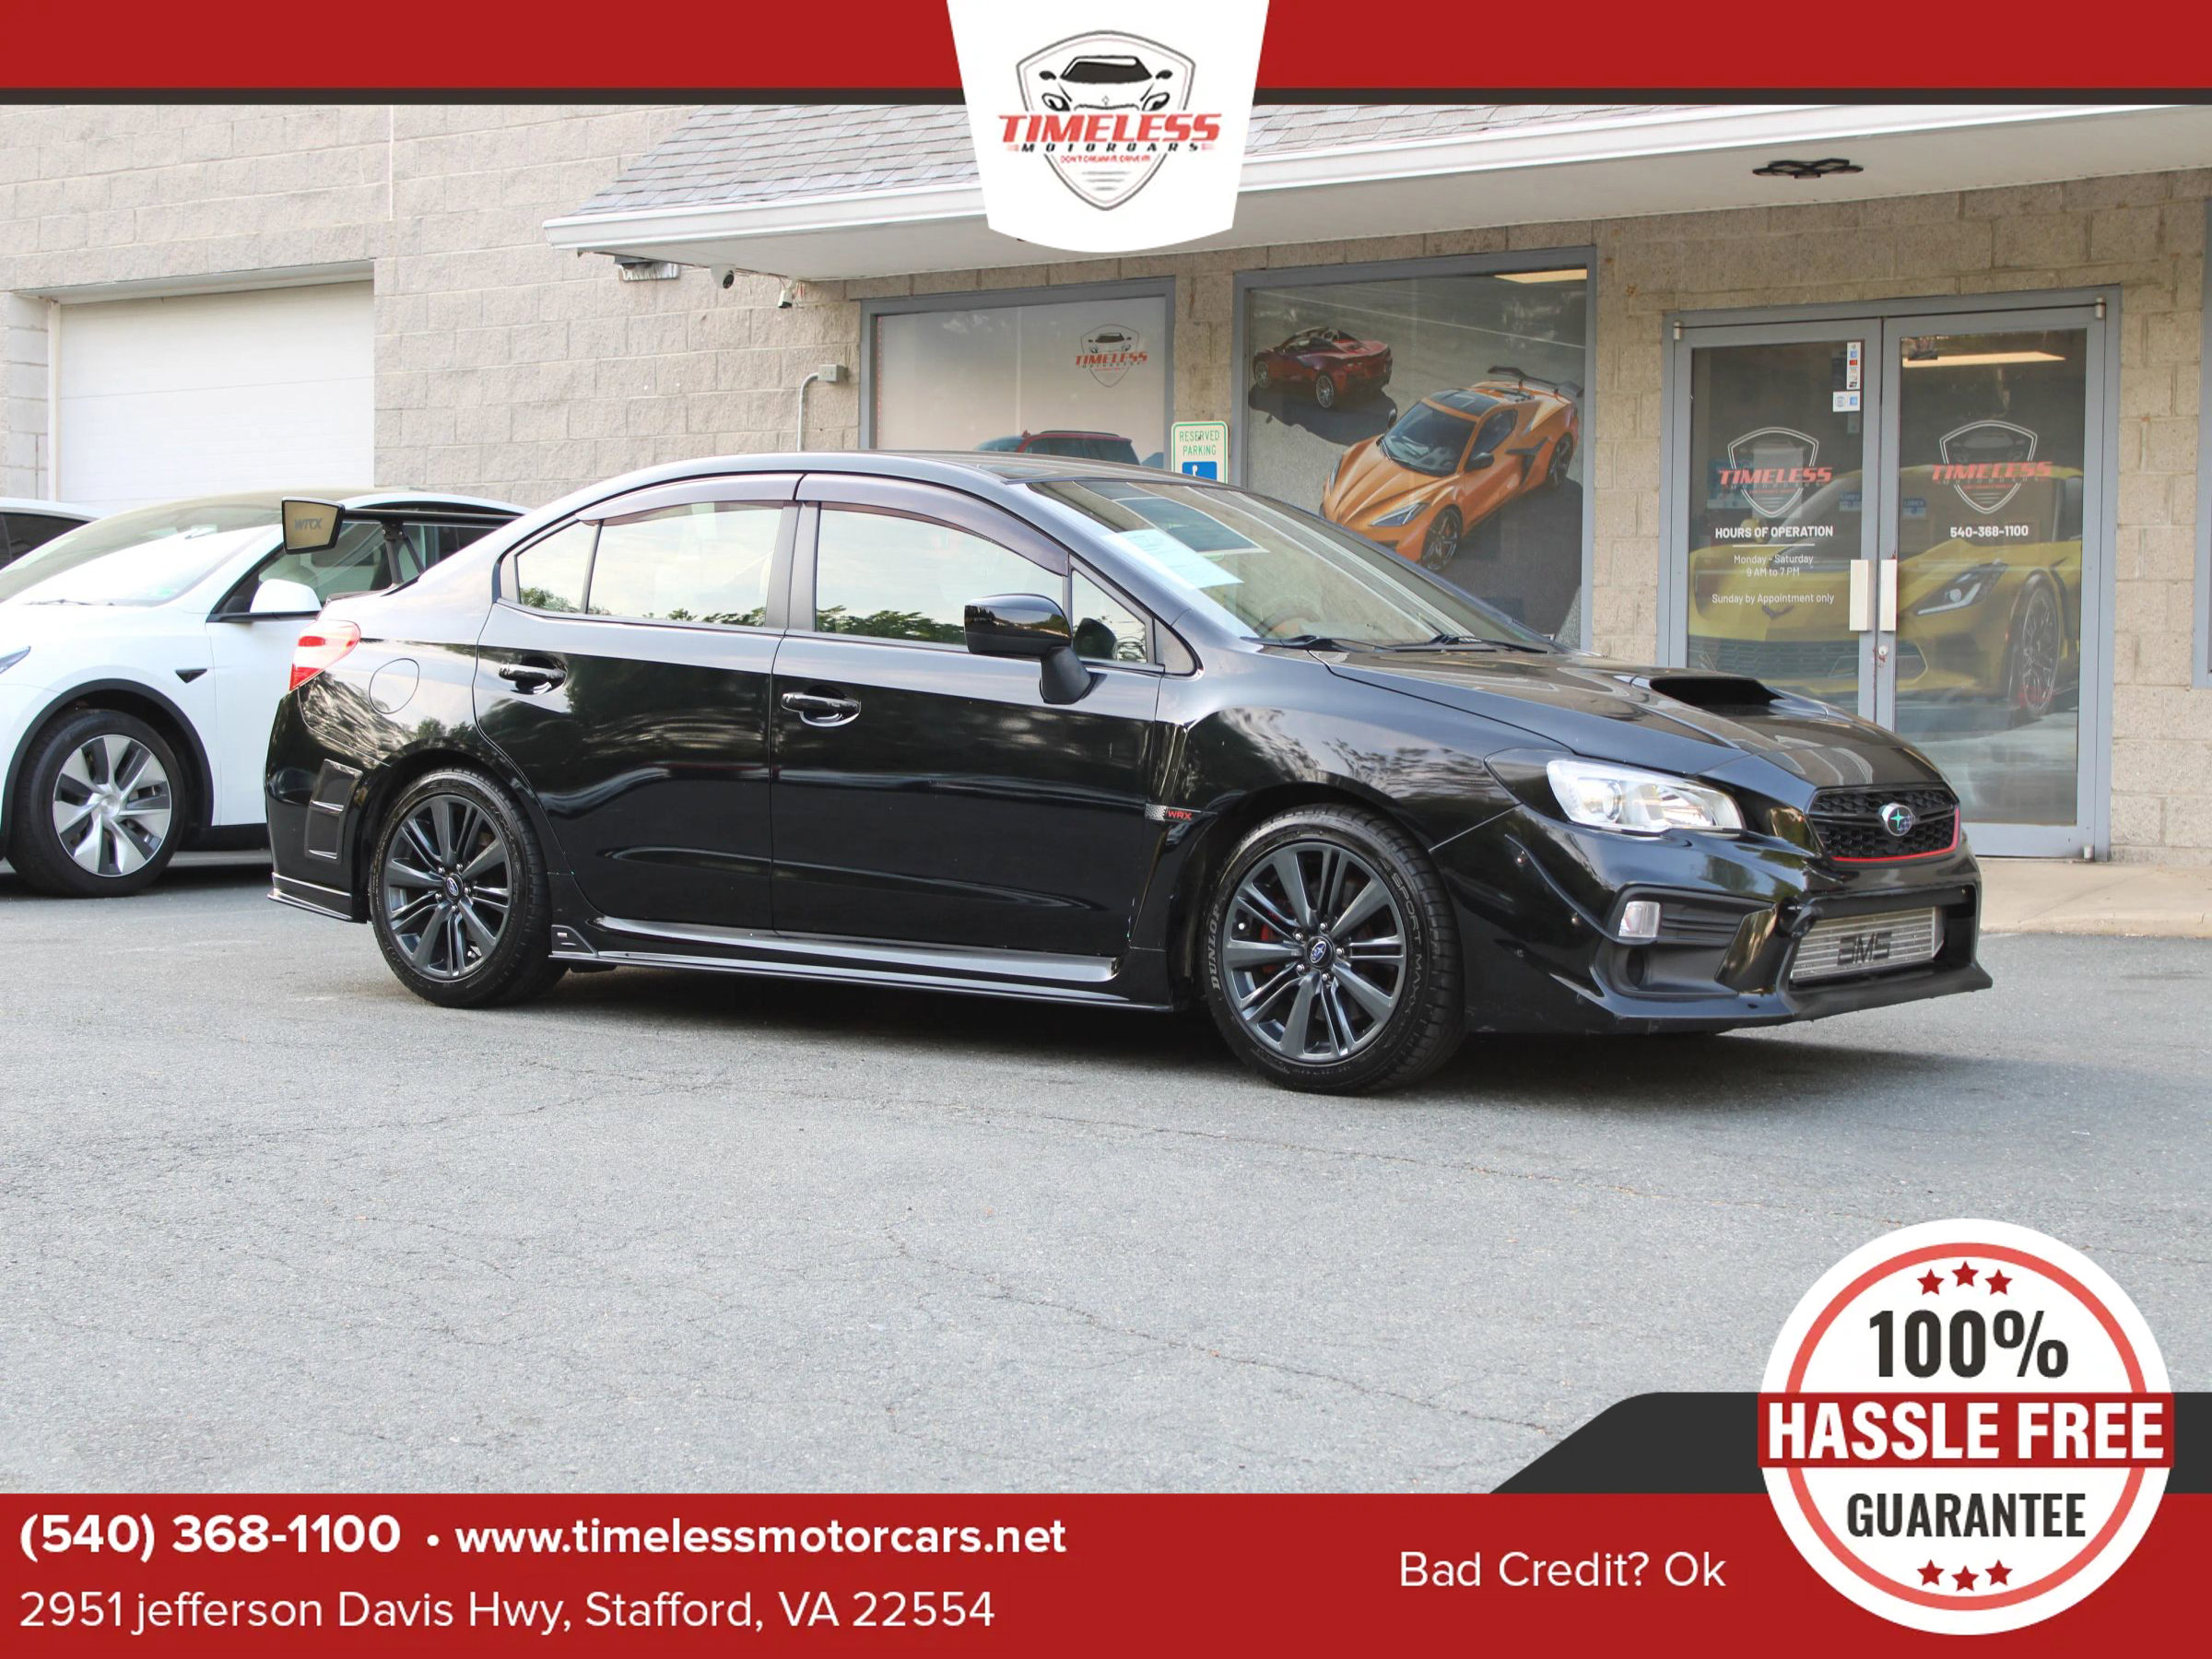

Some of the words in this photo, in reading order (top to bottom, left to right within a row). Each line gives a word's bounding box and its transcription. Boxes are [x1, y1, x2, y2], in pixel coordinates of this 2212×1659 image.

[1180, 429, 1220, 442] RESERVED
[1182, 444, 1217, 457] PARKING
[1718, 466, 1833, 486] TIMELESS
[1931, 461, 2053, 480] TIMELESS
[1715, 527, 1752, 538] HOURS
[1754, 527, 1770, 537] OF
[1771, 525, 1833, 537] OPERATION
[1949, 525, 2030, 537] 540-368-1100
[1734, 555, 1767, 567] Monday
[1774, 554, 1814, 566] Saturday
[1747, 569, 1752, 577] 9
[1754, 568, 1767, 578] AM
[1769, 568, 1778, 577] to
[1779, 567, 1785, 577] 7
[1787, 567, 1800, 576] PM
[1712, 594, 1744, 605] Sunday
[1745, 594, 1756, 604] by
[1757, 593, 1814, 605] Appointment
[1816, 593, 1834, 605] only
[1168, 809, 1193, 821] WRX
[1391, 872, 1422, 946] SPORT
[1208, 904, 1221, 990] DUNLOP
